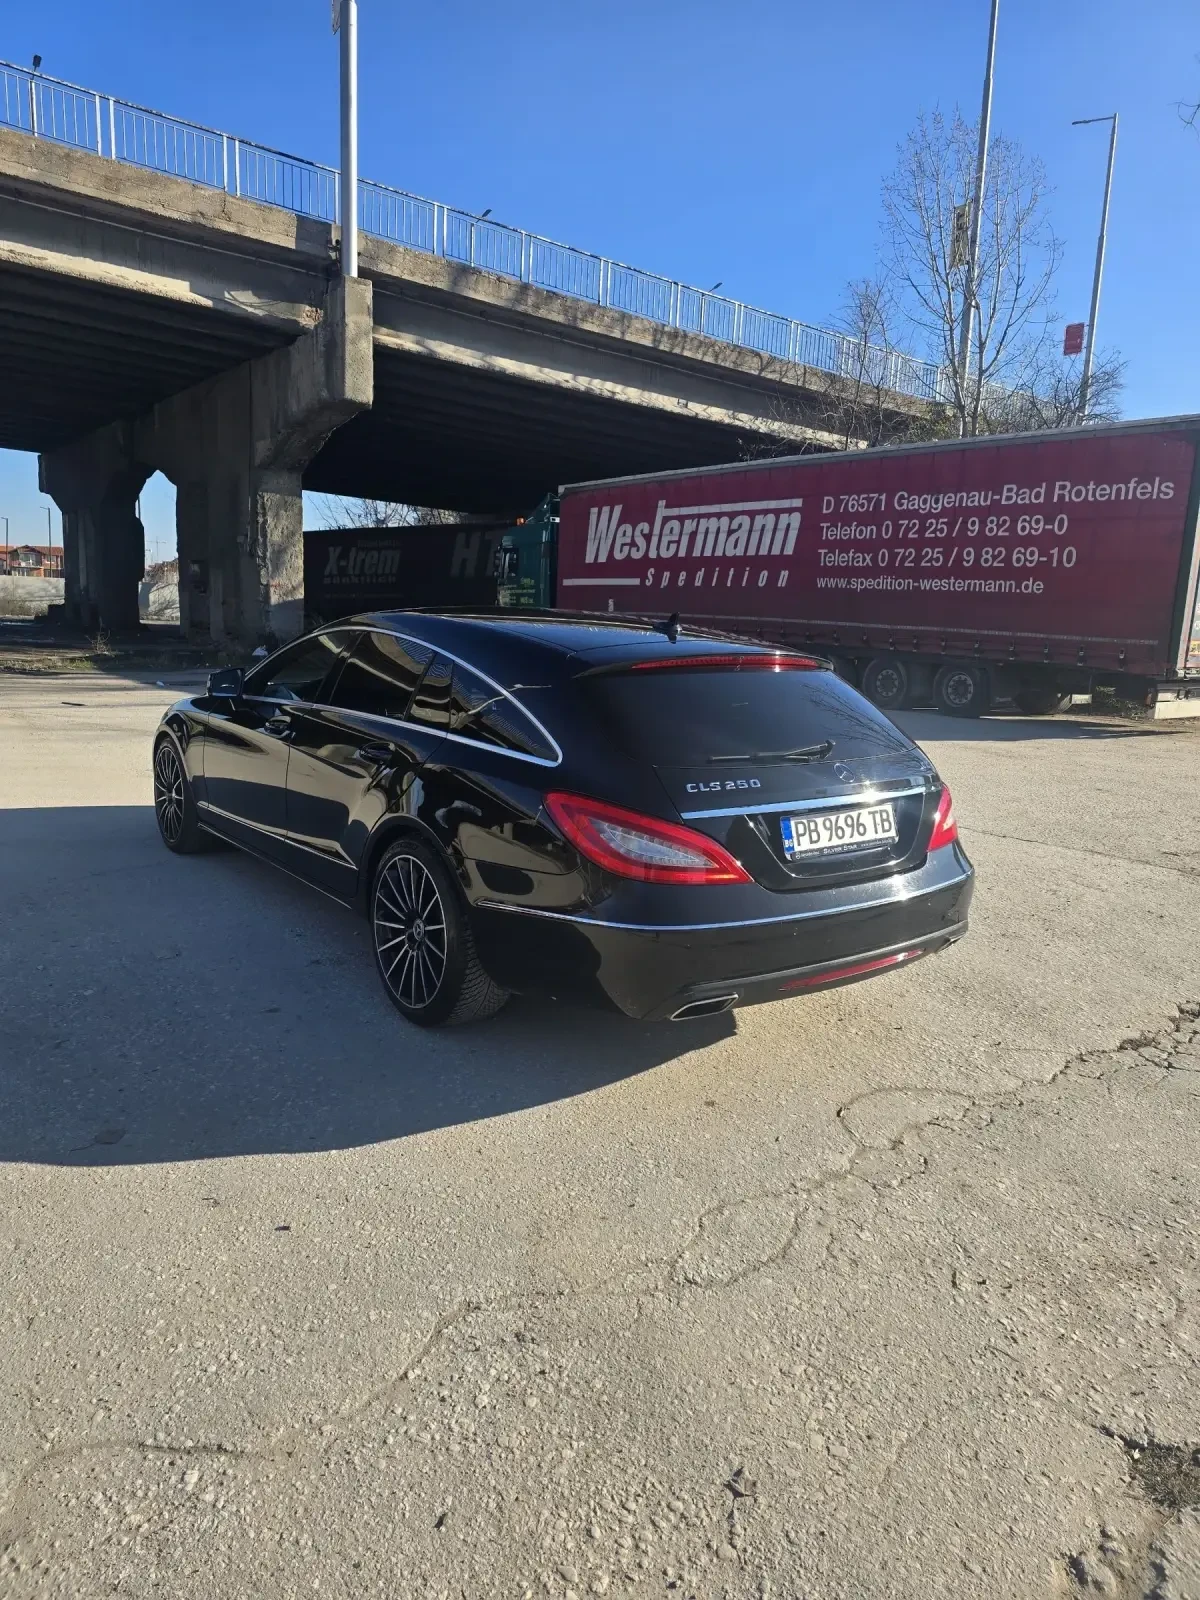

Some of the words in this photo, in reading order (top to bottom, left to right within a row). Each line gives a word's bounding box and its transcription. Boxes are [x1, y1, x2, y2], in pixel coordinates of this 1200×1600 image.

[823, 497, 834, 514] D
[839, 494, 886, 513] 76571
[894, 484, 1045, 514] Gaggenau-Bad
[1053, 477, 1175, 503] Rotenfels
[585, 499, 803, 563] Westermann
[820, 521, 876, 540] Telefon
[882, 521, 892, 538] 0
[898, 520, 919, 538] 72
[925, 518, 947, 537] 25
[952, 517, 963, 537] /
[967, 517, 979, 536] 9
[985, 516, 1010, 536] 82
[1017, 514, 1068, 535] 69-0
[818, 549, 872, 567] Telefax
[878, 549, 888, 567] 0
[894, 549, 915, 567] 72
[921, 548, 943, 567] 25
[948, 548, 957, 567] /
[963, 548, 974, 566] 9
[980, 547, 1005, 567] 82
[1012, 546, 1077, 567] 69-10
[645, 567, 789, 588] Spedition
[817, 575, 1044, 593] www.spedition-westermann.de
[686, 782, 721, 793] CLS
[725, 779, 761, 789] 250
[794, 819, 820, 846] PB
[822, 812, 867, 842] 9696
[868, 809, 892, 834] TB
